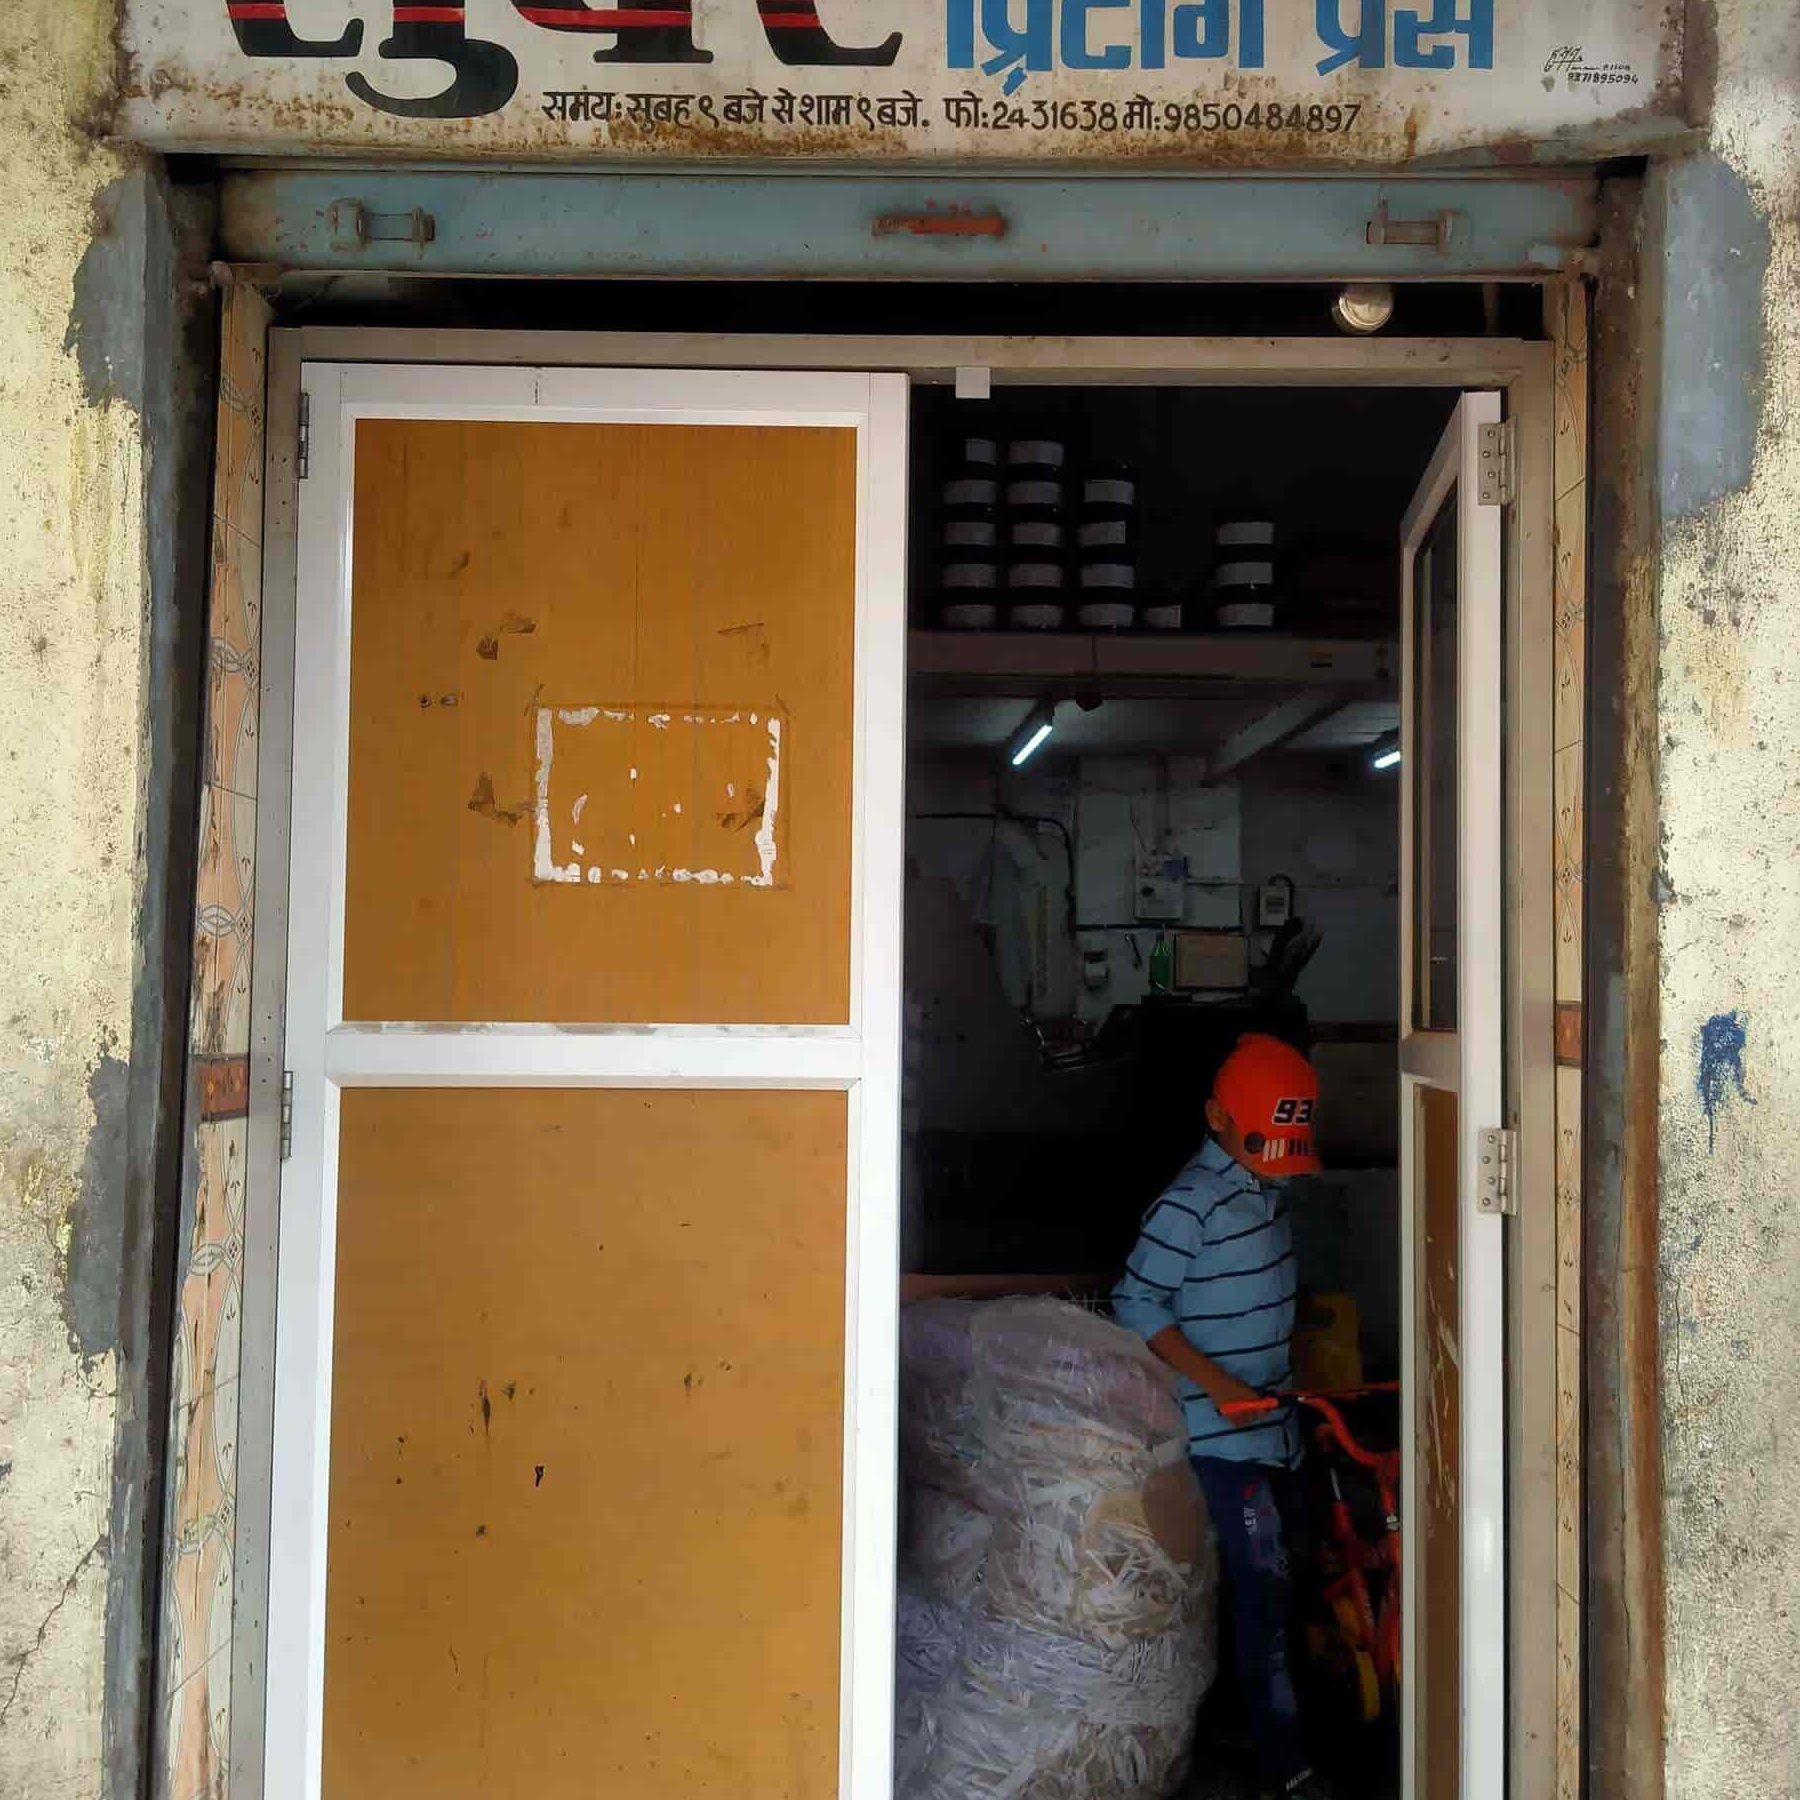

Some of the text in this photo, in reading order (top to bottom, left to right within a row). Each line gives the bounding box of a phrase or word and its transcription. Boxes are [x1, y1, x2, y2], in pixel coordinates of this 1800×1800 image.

[1316, 0, 1494, 77] प्रस
[625, 93, 696, 133] सुबह
[723, 87, 769, 124] बजे
[771, 87, 797, 125] से
[798, 93, 854, 126] शाम
[1272, 1098, 1313, 1126] 93
